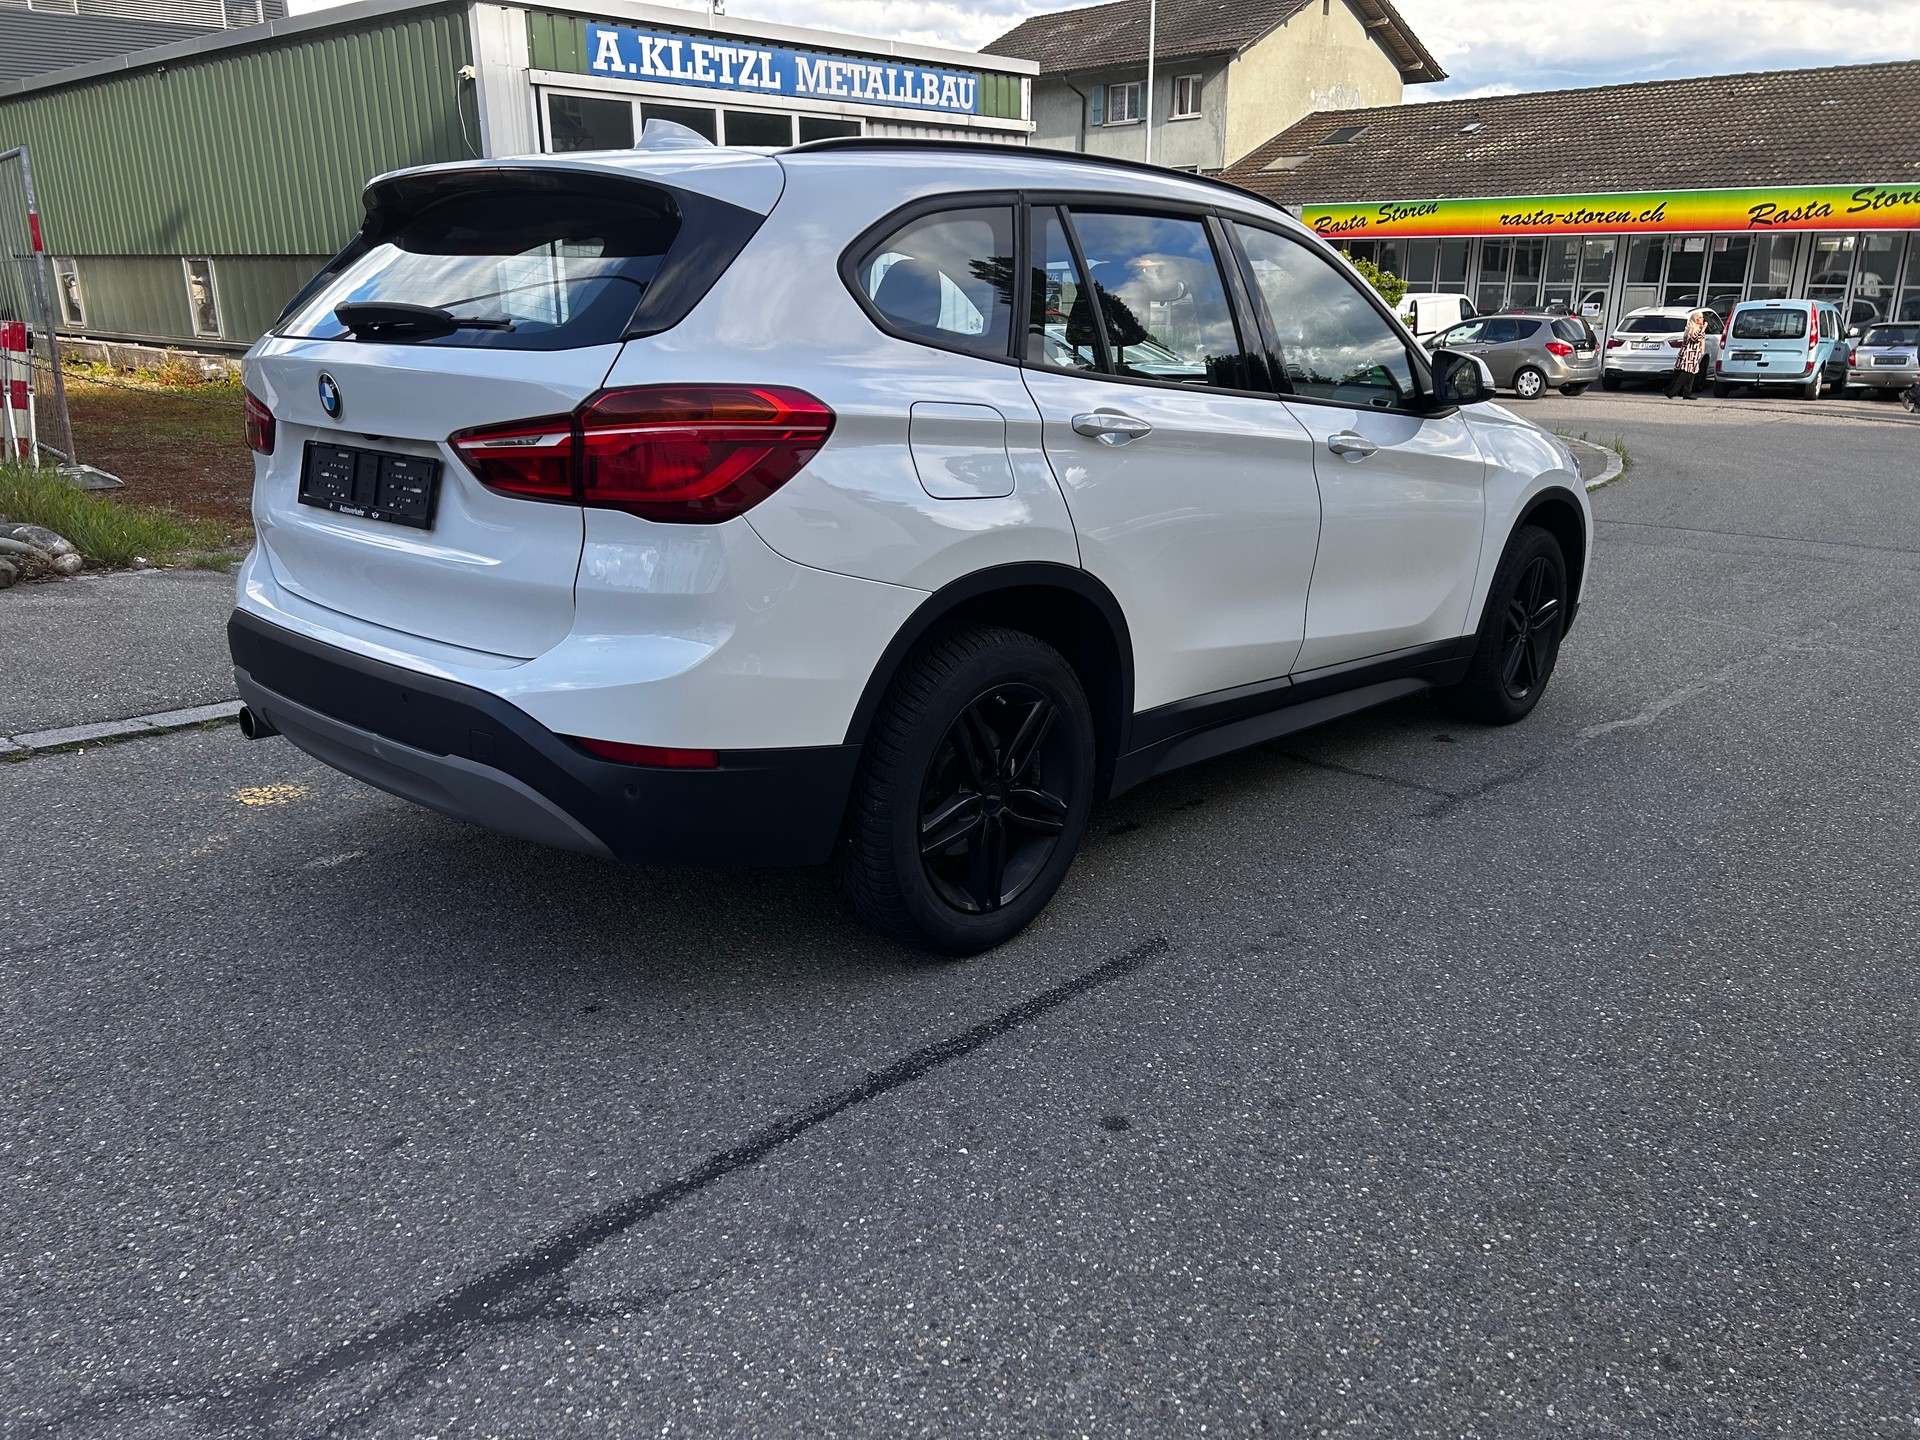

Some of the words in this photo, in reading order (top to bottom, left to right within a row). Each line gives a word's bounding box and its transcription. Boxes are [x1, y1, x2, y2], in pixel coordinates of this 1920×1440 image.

[593, 30, 781, 89] A.KLETZL
[795, 56, 975, 110] METALLBAU
[1314, 215, 1368, 234] Rasta
[1376, 203, 1439, 224] Storen
[1499, 201, 1667, 226] rasta-storen.ch
[1748, 201, 1834, 229] Rasta
